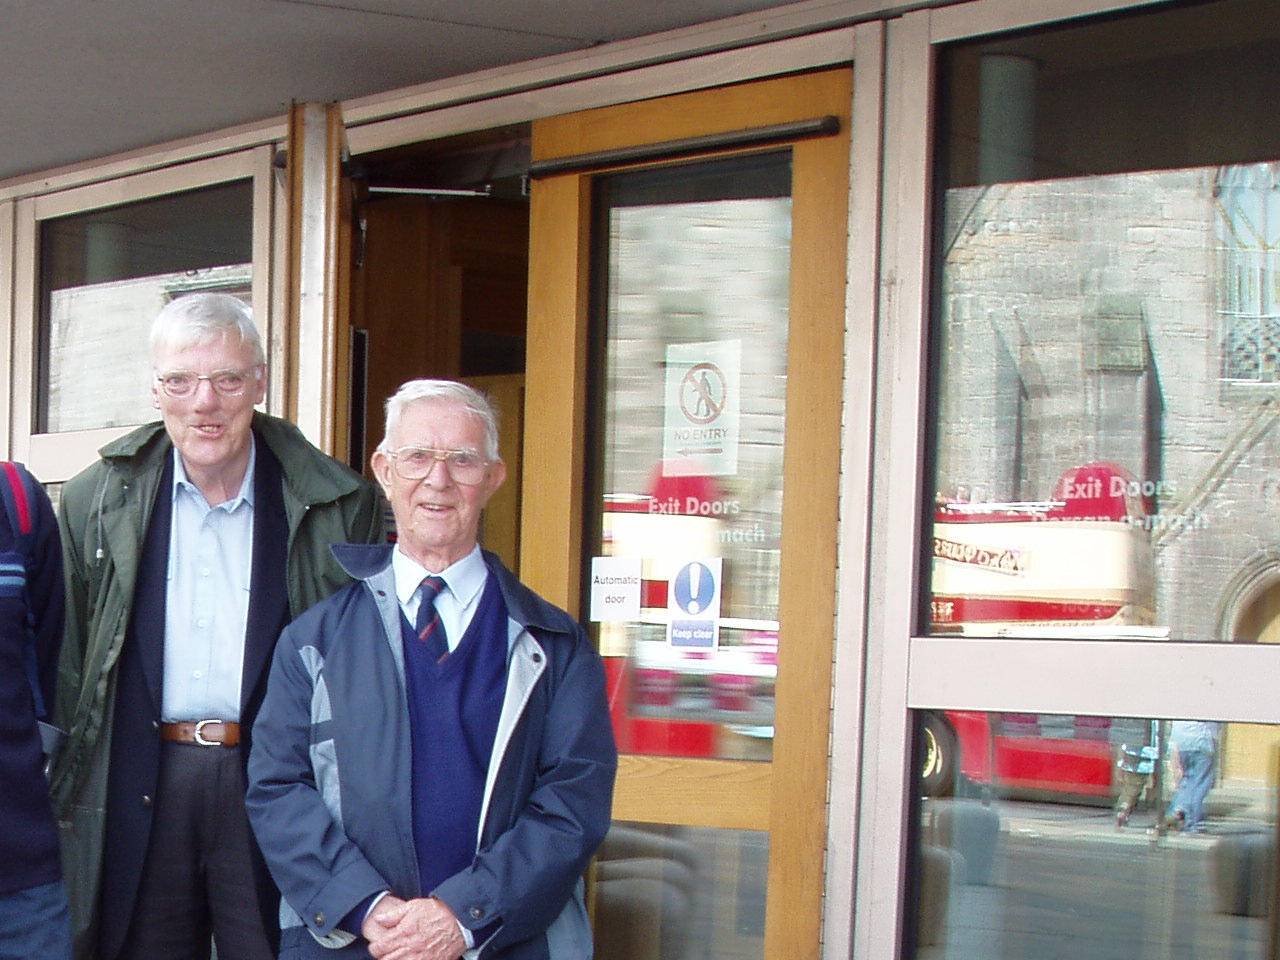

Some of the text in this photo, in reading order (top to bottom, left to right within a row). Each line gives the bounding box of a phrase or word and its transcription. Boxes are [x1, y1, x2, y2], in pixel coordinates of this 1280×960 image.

[674, 428, 728, 440] NO ENTRY
[1062, 475, 1177, 499] Exit Doors
[648, 496, 740, 515] Exit Doors
[593, 575, 639, 585] Automatic
[604, 594, 626, 604] door
[672, 629, 714, 640] Keep clear
